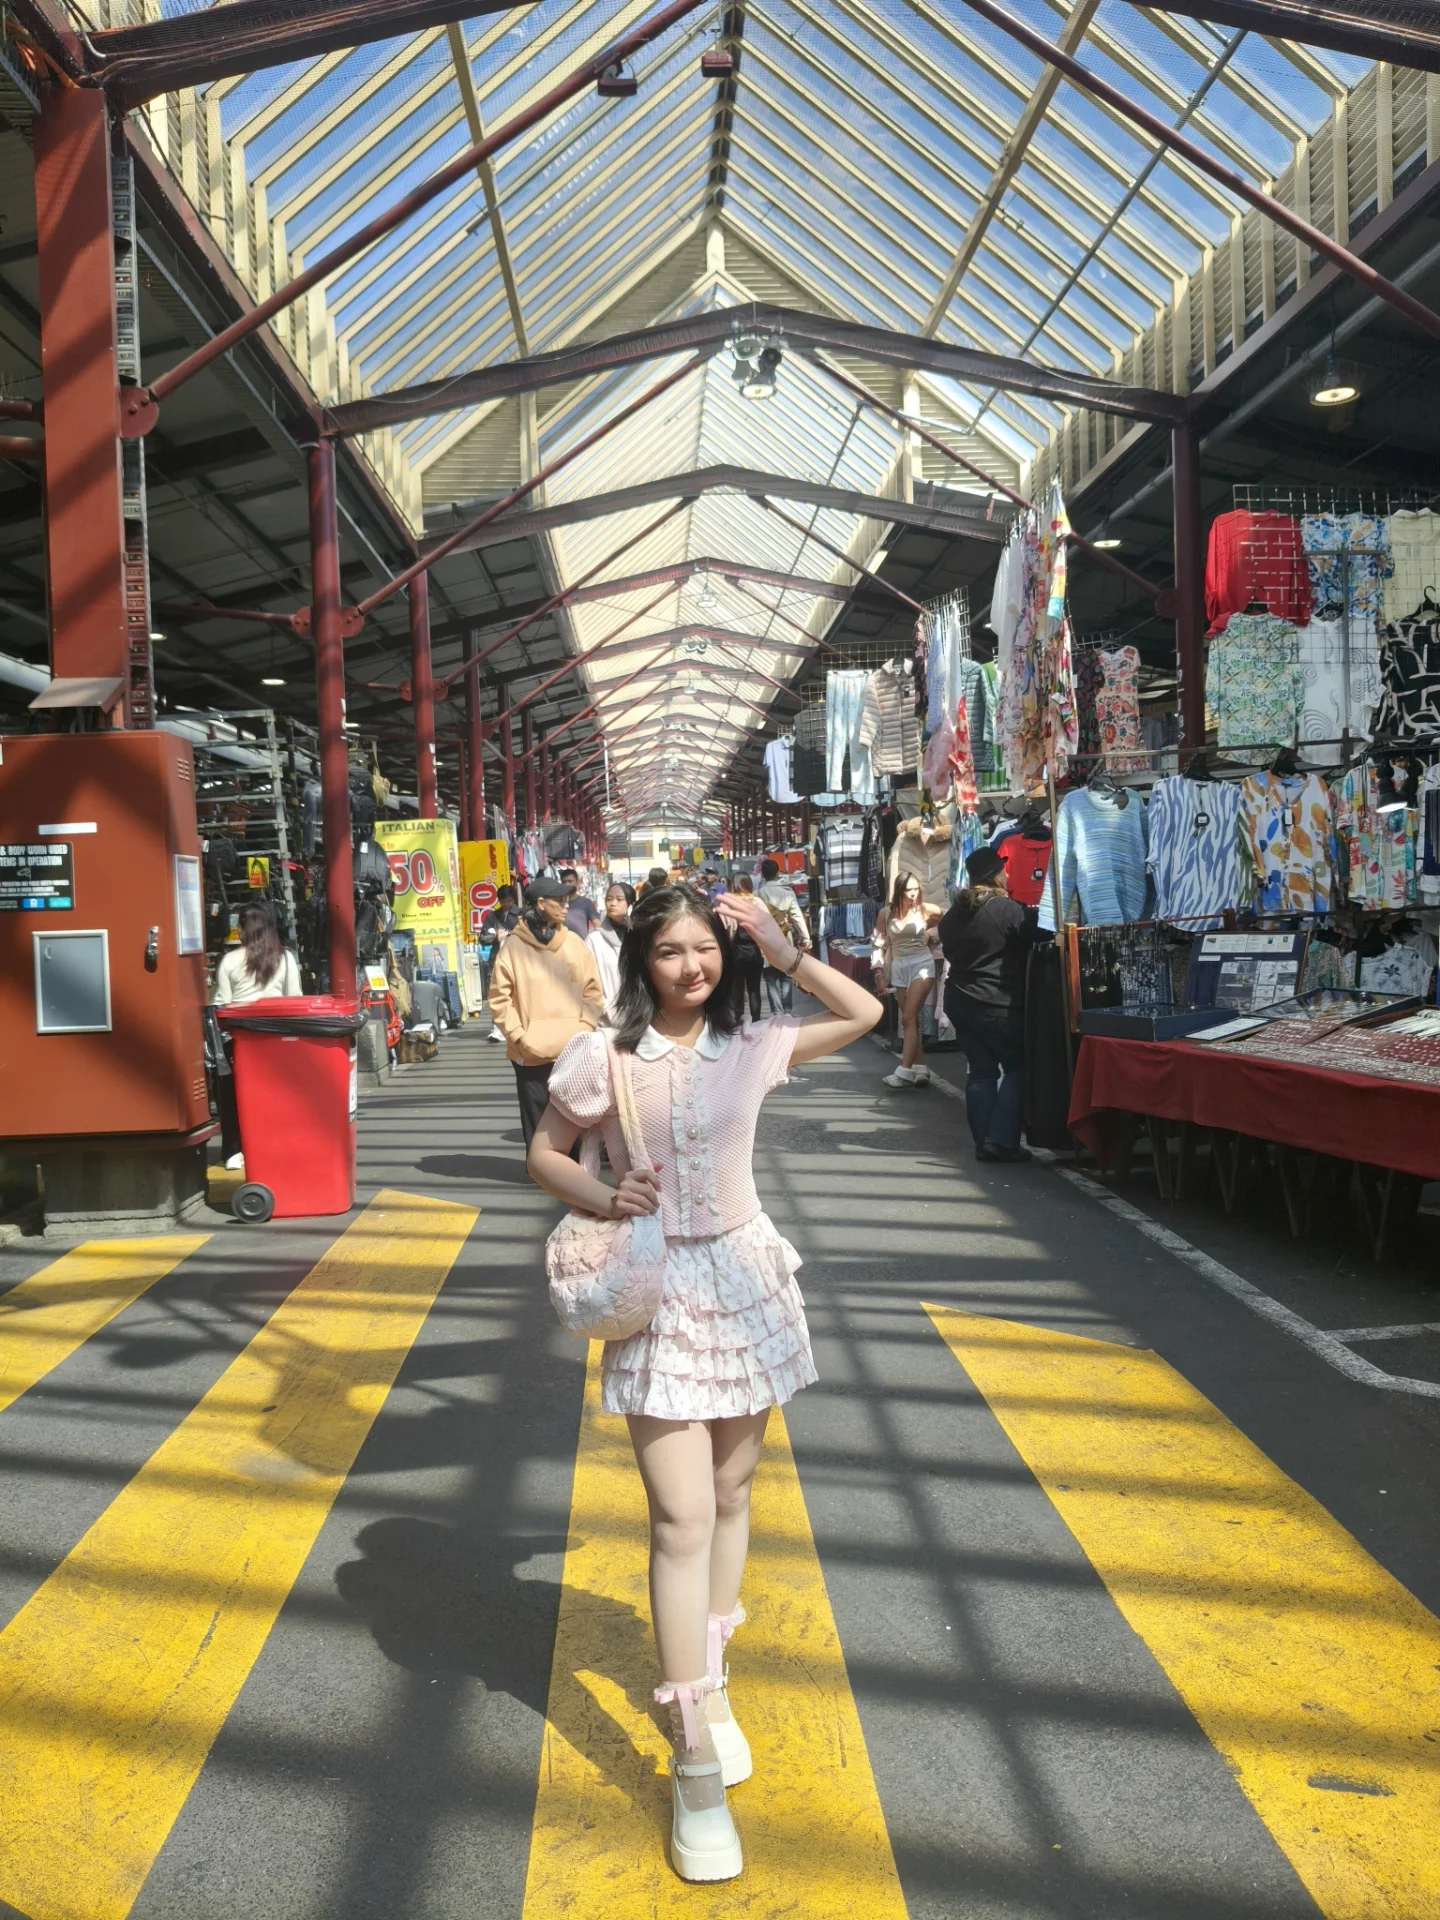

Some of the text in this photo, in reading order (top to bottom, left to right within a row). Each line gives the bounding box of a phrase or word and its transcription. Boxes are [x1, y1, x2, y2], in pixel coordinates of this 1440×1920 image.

[382, 822, 435, 832] ITALIAN
[8, 846, 25, 855] BODY
[28, 845, 47, 855] WORN
[49, 845, 67, 854] VIDEO
[18, 857, 26, 866] IN
[27, 856, 62, 866] OPERATION
[488, 843, 497, 869] OFF
[417, 896, 445, 908] OFF
